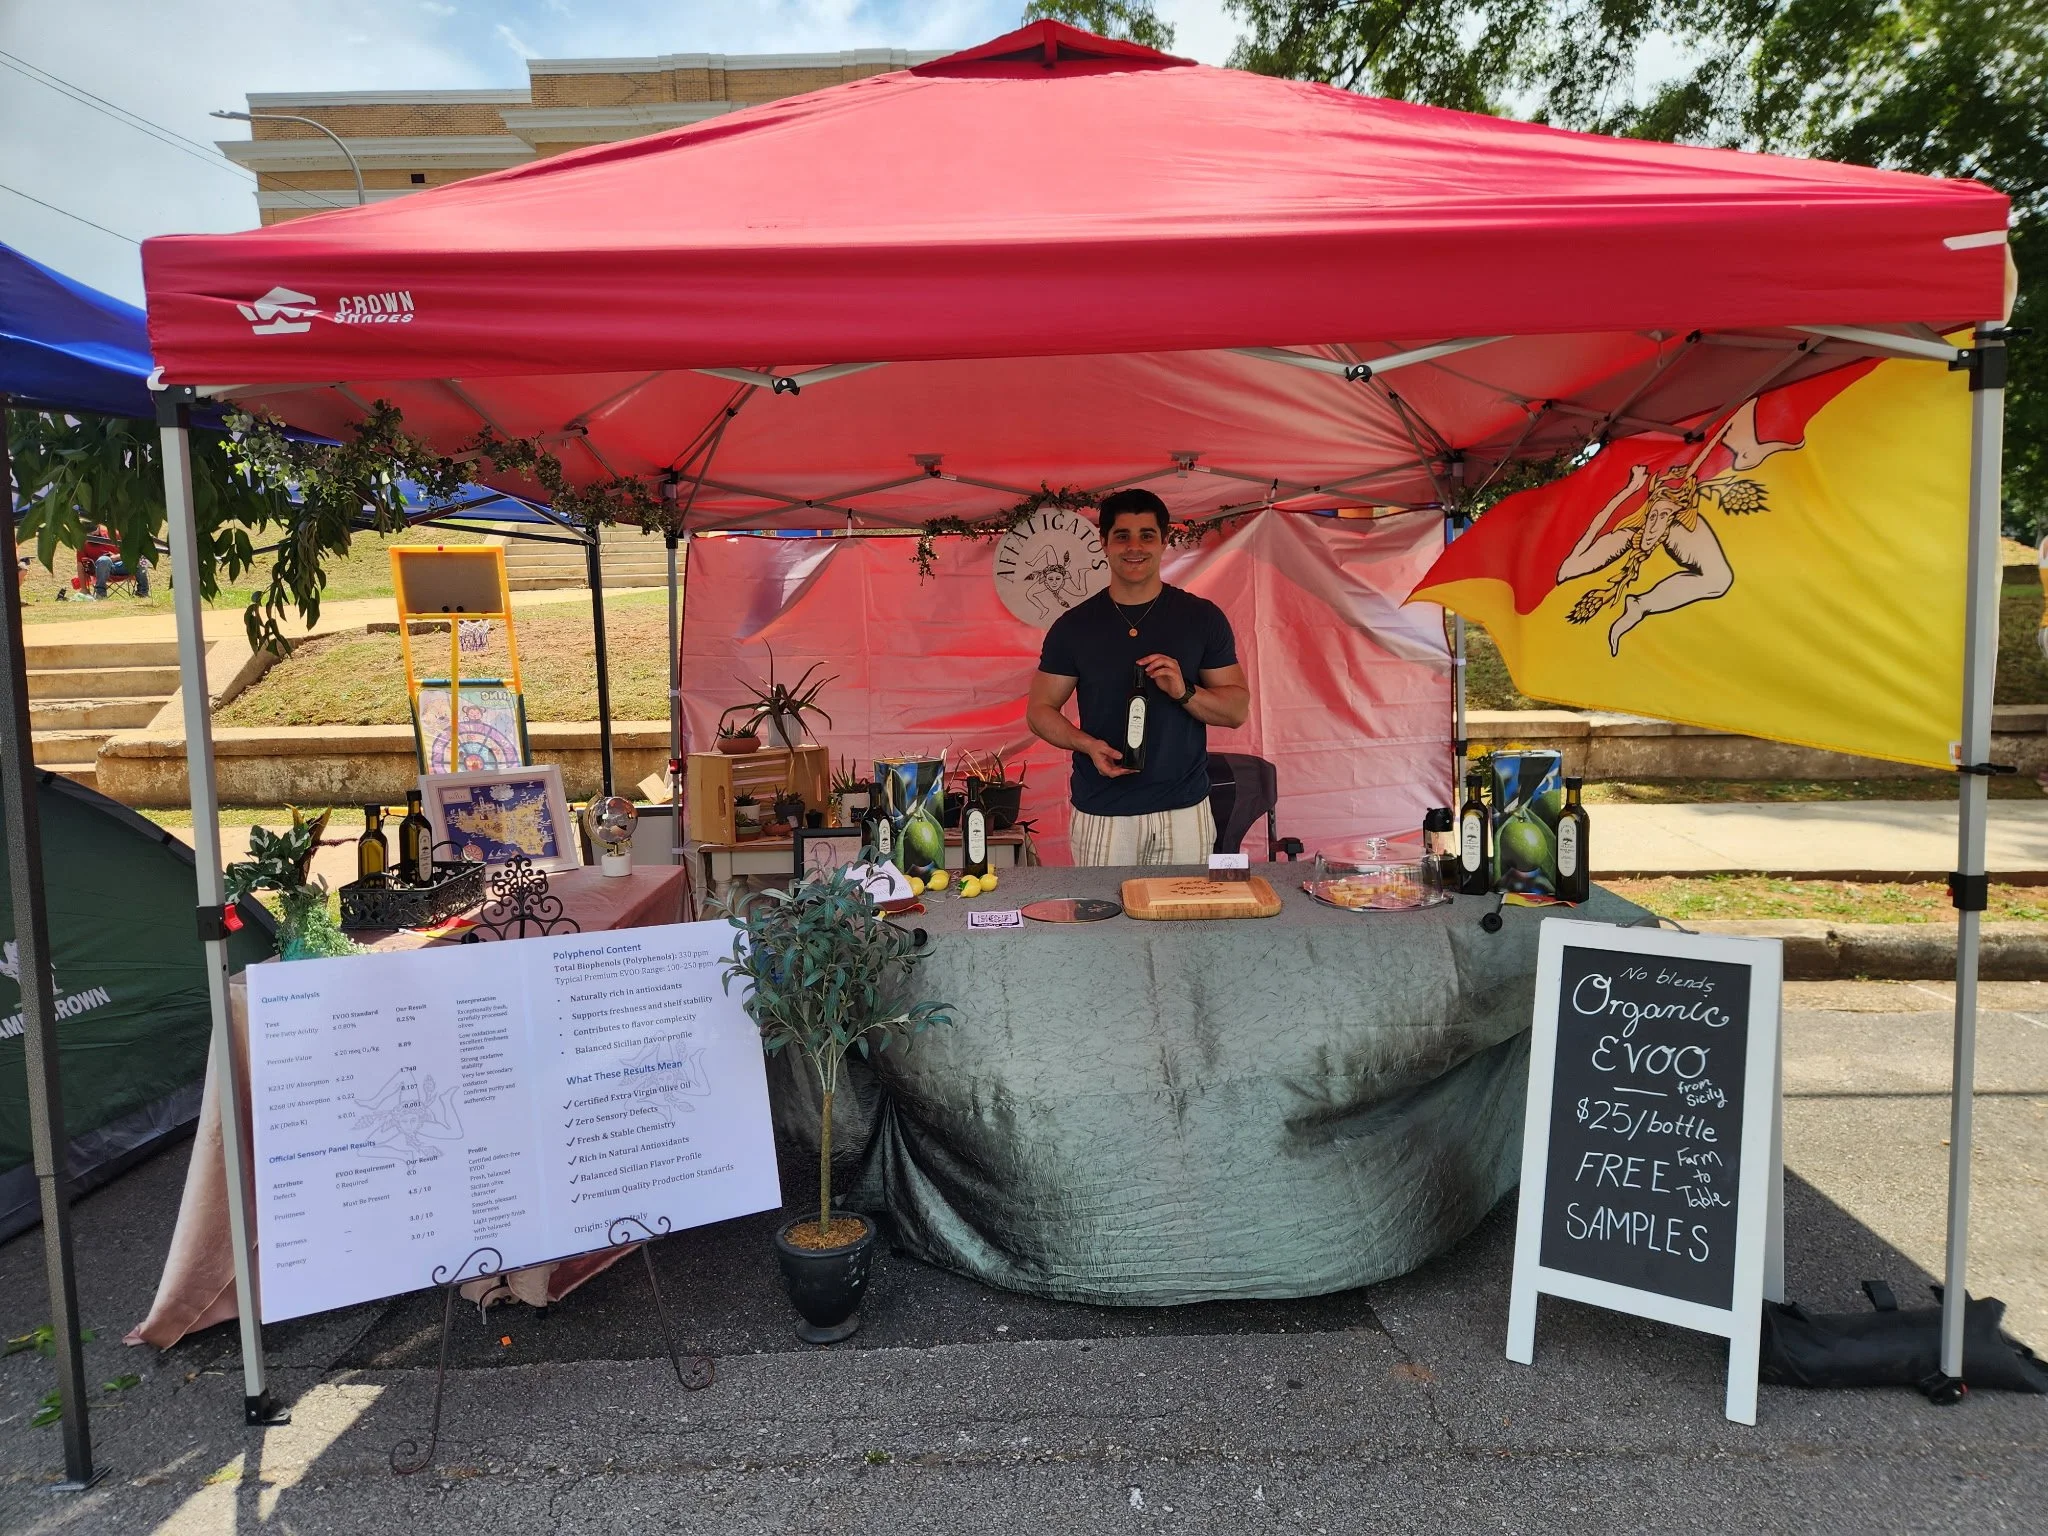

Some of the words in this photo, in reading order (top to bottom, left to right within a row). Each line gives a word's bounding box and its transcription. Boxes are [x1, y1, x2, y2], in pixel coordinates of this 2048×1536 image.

[339, 290, 415, 315] CROWN
[334, 312, 414, 324] SHADES
[997, 513, 1109, 584] AFFATIGATOS
[553, 947, 604, 960] Polyphenol
[606, 944, 642, 954] Content
[554, 964, 575, 973] Total
[577, 958, 621, 972] Biophenols
[622, 953, 677, 966] (Polyphenols):
[555, 975, 583, 986] Typical
[584, 970, 618, 981] Premium
[620, 968, 640, 977] EVOO
[642, 966, 666, 975] Range:
[1620, 967, 1648, 981] No
[1656, 968, 1716, 993] blends
[261, 995, 289, 1004] Quality
[290, 991, 320, 1000] Analysis
[570, 990, 608, 1003] Naturally
[609, 988, 625, 997] rich
[626, 988, 634, 996] in
[636, 982, 683, 994] antioxidants
[572, 1008, 608, 1021] Supports
[609, 1003, 647, 1016] freshness
[648, 1001, 662, 1010] and
[664, 998, 682, 1008] shelf
[683, 994, 713, 1006] stability
[1572, 973, 1730, 1038] Organic
[574, 1024, 621, 1037] Contributes
[622, 1022, 630, 1030] to
[631, 1019, 654, 1028] flavor
[655, 1012, 697, 1026] complexity
[575, 1042, 612, 1055] Balanced
[614, 1038, 642, 1049] Sicilian
[643, 1035, 666, 1044] flavor
[667, 1030, 693, 1042] profile
[1591, 1035, 1711, 1079] EVOO
[297, 1079, 330, 1088] Absorption
[566, 1076, 592, 1086] What
[594, 1070, 621, 1081] These
[623, 1065, 656, 1076] Results
[657, 1060, 683, 1070] Mean
[574, 1095, 609, 1108] Certified
[610, 1091, 632, 1102] Extra
[633, 1087, 658, 1098] Virgin
[659, 1084, 679, 1093] Olive
[680, 1081, 691, 1090] Oil
[1676, 1078, 1713, 1095] from
[297, 1097, 331, 1107] Absorption
[1686, 1088, 1729, 1109] Sicily
[575, 1116, 595, 1127] Zero
[596, 1110, 628, 1123] Sensory
[629, 1104, 658, 1116] Defects
[1576, 1096, 1718, 1143] $25/bottle
[577, 1134, 601, 1145] Fresh
[602, 1132, 609, 1141] &
[610, 1128, 635, 1139] Stable
[636, 1120, 676, 1134] Chemistry
[269, 1153, 296, 1164] Official
[297, 1149, 327, 1159] Sensory
[328, 1144, 349, 1154] Panel
[350, 1140, 376, 1150] Results
[578, 1153, 598, 1164] Rich
[599, 1152, 607, 1160] in
[608, 1145, 639, 1157] Natural
[640, 1136, 690, 1152] Antioxidants
[1676, 1146, 1724, 1167] Farm
[355, 1163, 395, 1175] Requirement
[580, 1168, 618, 1182] Balanced
[619, 1163, 649, 1174] Sicilian
[650, 1158, 675, 1168] Flavor
[676, 1152, 702, 1163] Profile
[1575, 1151, 1671, 1194] FREE
[1692, 1169, 1711, 1184] to
[273, 1180, 304, 1189] Attribute
[341, 1179, 369, 1189] Required
[582, 1187, 620, 1201] Premium
[622, 1182, 651, 1194] Quality
[652, 1172, 695, 1187] Production
[696, 1163, 734, 1177] Standards
[274, 1192, 296, 1201] Defects
[1675, 1185, 1731, 1210] Table
[574, 1222, 603, 1234] Origin:
[1566, 1202, 1710, 1263] SAMPLES
[275, 1238, 308, 1248] Bitterness
[276, 1258, 307, 1268] Pungency
